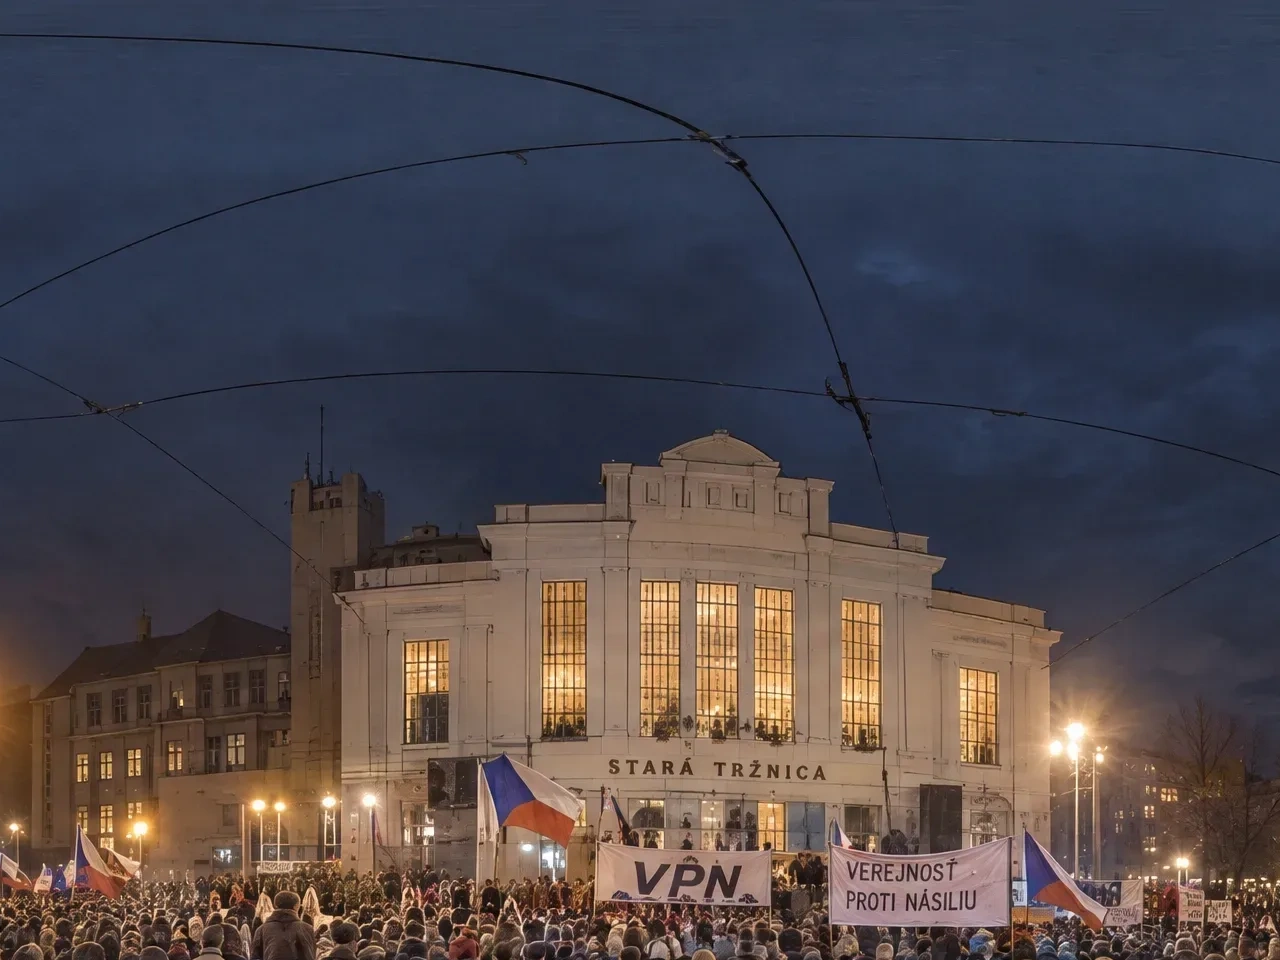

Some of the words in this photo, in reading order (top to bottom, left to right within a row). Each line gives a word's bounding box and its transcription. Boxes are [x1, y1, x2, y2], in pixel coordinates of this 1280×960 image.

[608, 757, 694, 776] STARÁ
[713, 759, 827, 781] TRŽNICA
[634, 861, 743, 899] VPN
[846, 858, 958, 882] VEREJNOSŤ
[846, 890, 896, 911] PROTI
[905, 888, 977, 912] NÁSILIU
